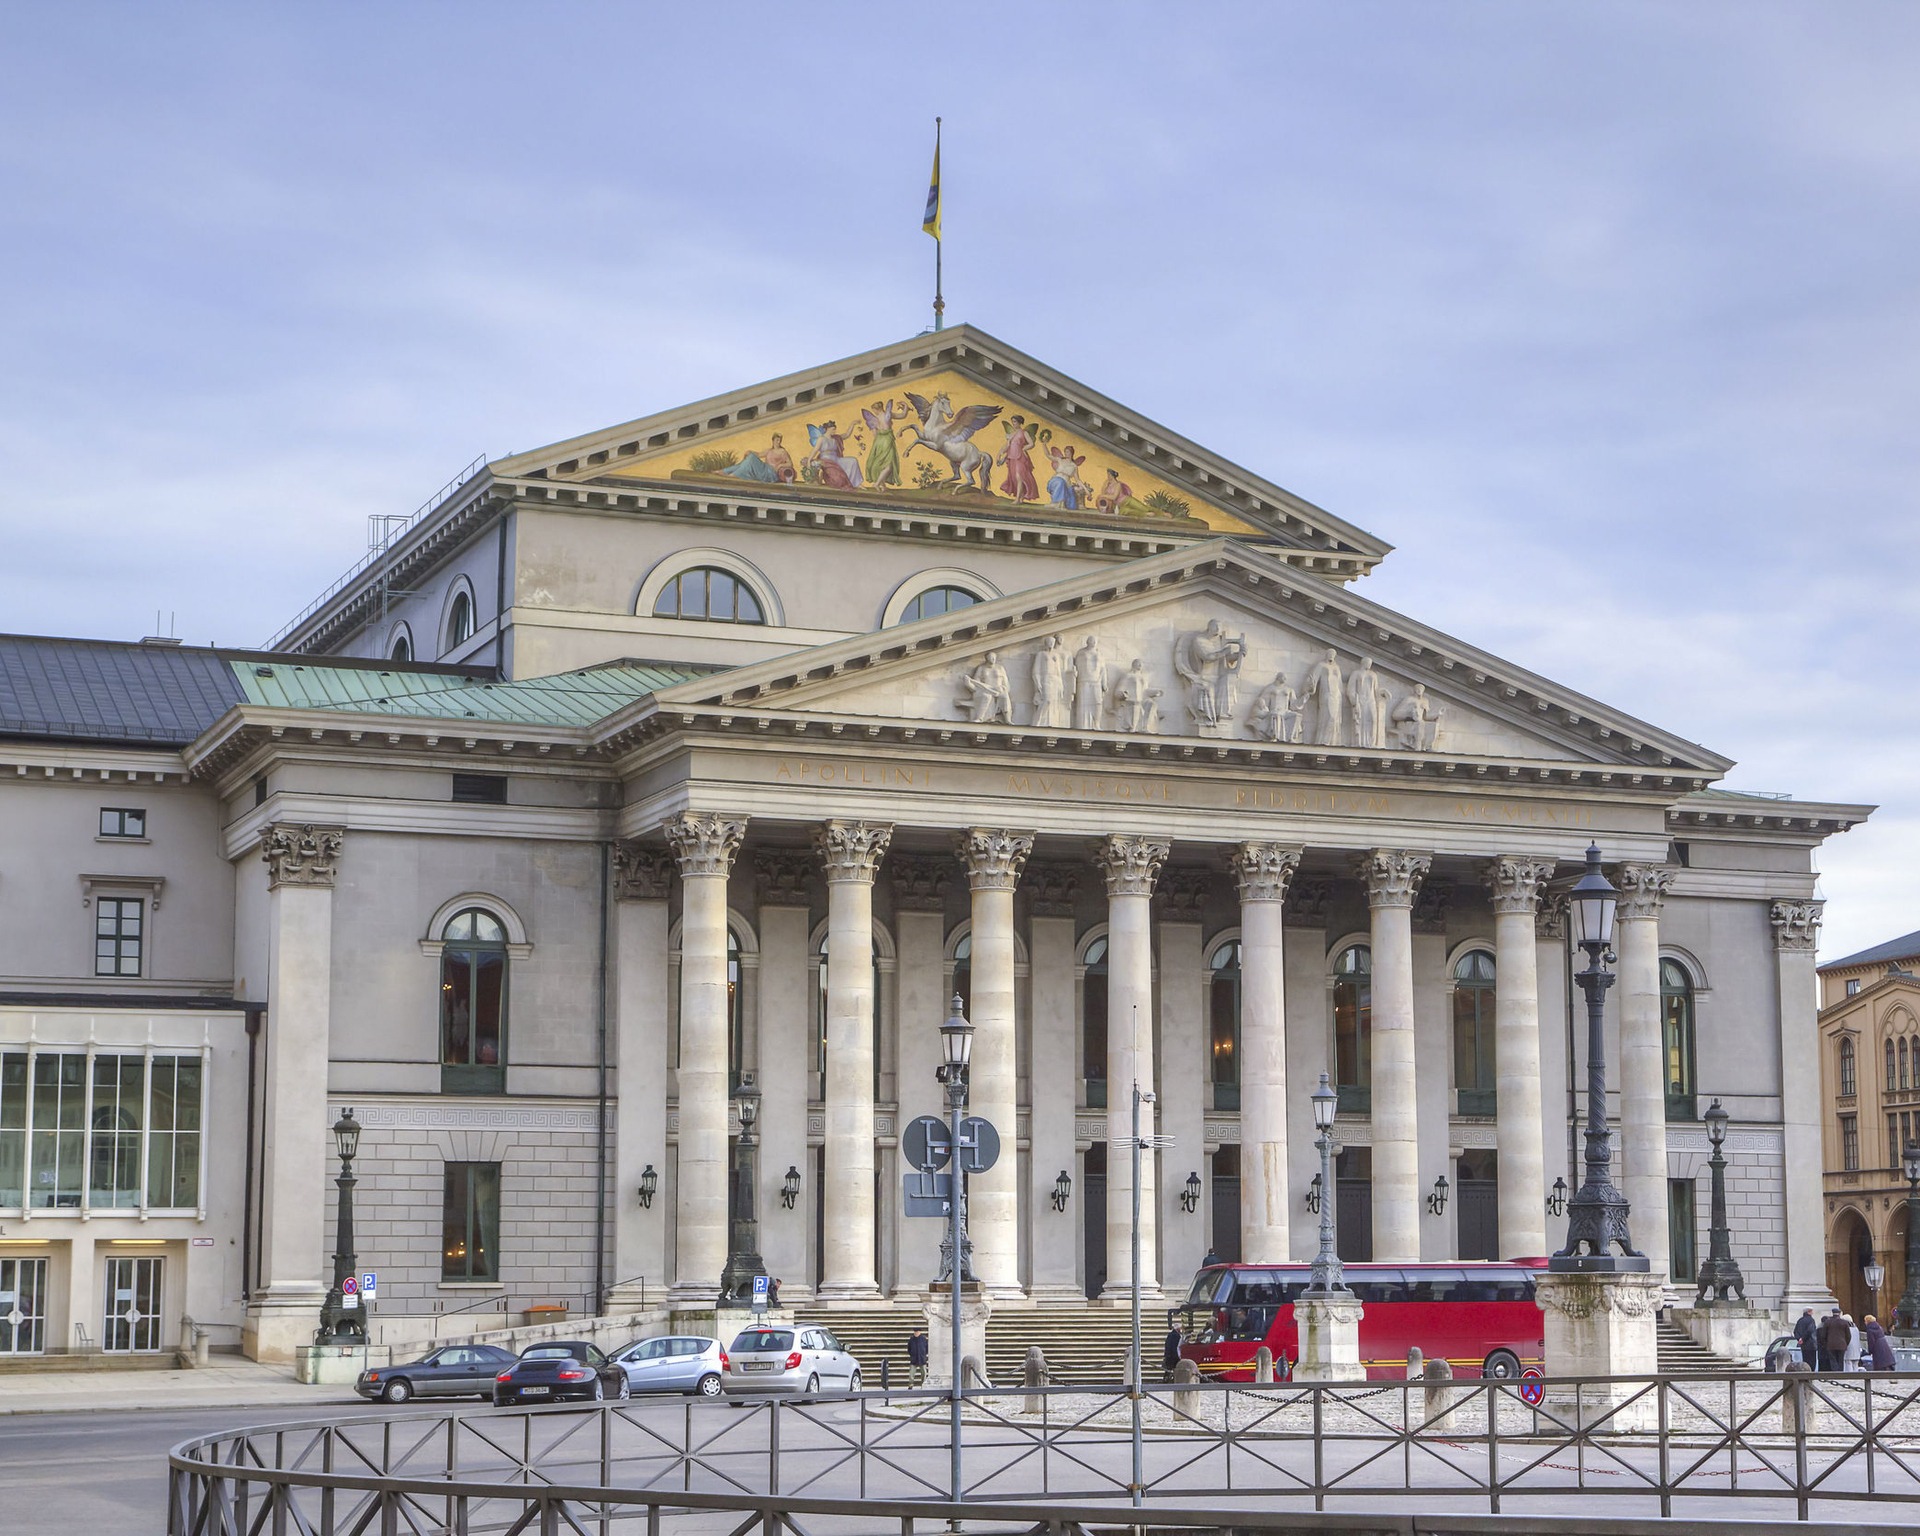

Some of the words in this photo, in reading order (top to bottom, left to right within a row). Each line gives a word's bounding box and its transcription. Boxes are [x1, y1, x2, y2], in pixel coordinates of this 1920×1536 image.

[776, 762, 930, 786] APOLLINI
[1007, 774, 1172, 800] MVSISQVE
[1455, 802, 1593, 826] MCMLXIII
[364, 1275, 373, 1289] P
[755, 1278, 764, 1292] P
